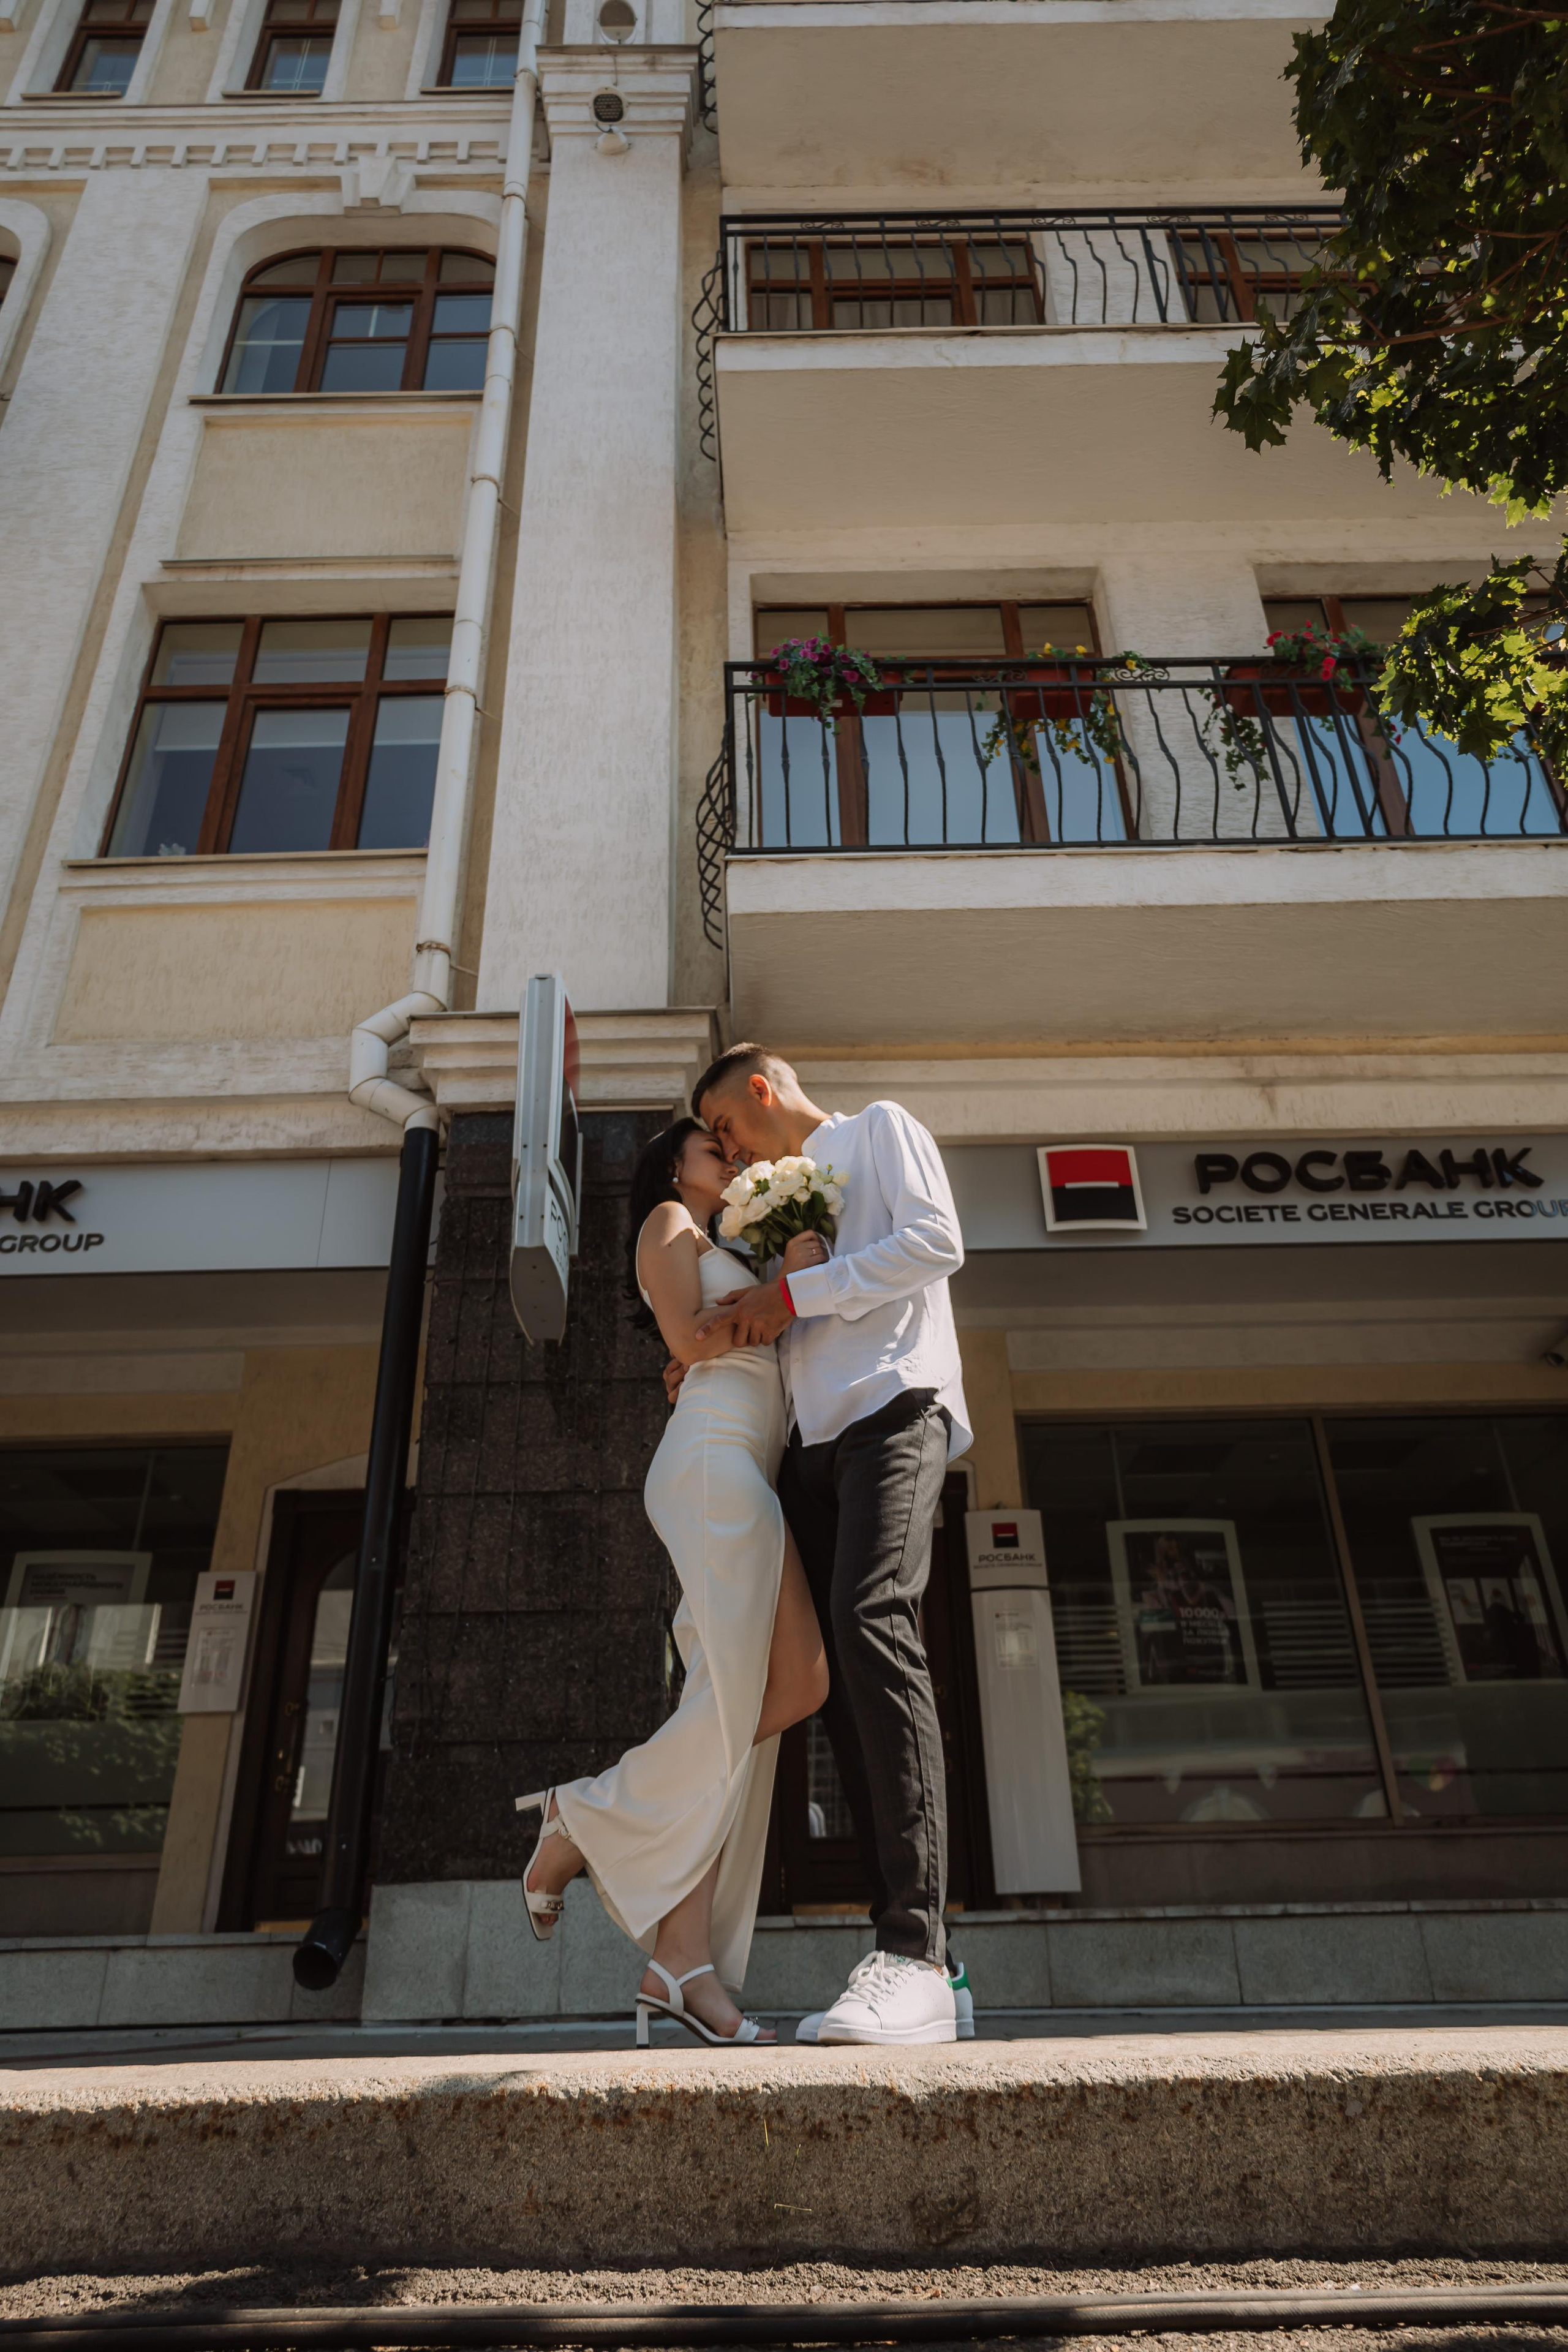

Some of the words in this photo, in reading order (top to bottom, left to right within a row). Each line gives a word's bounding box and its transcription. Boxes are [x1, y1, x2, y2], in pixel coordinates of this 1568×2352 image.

[1194, 1147, 1545, 1194] РОСБАНК
[1171, 1204, 1302, 1224] SOCIETE
[1306, 1201, 1468, 1221] GENERALE
[0, 1233, 104, 1253] GROUP
[978, 1552, 1036, 1562] РОСБАНК
